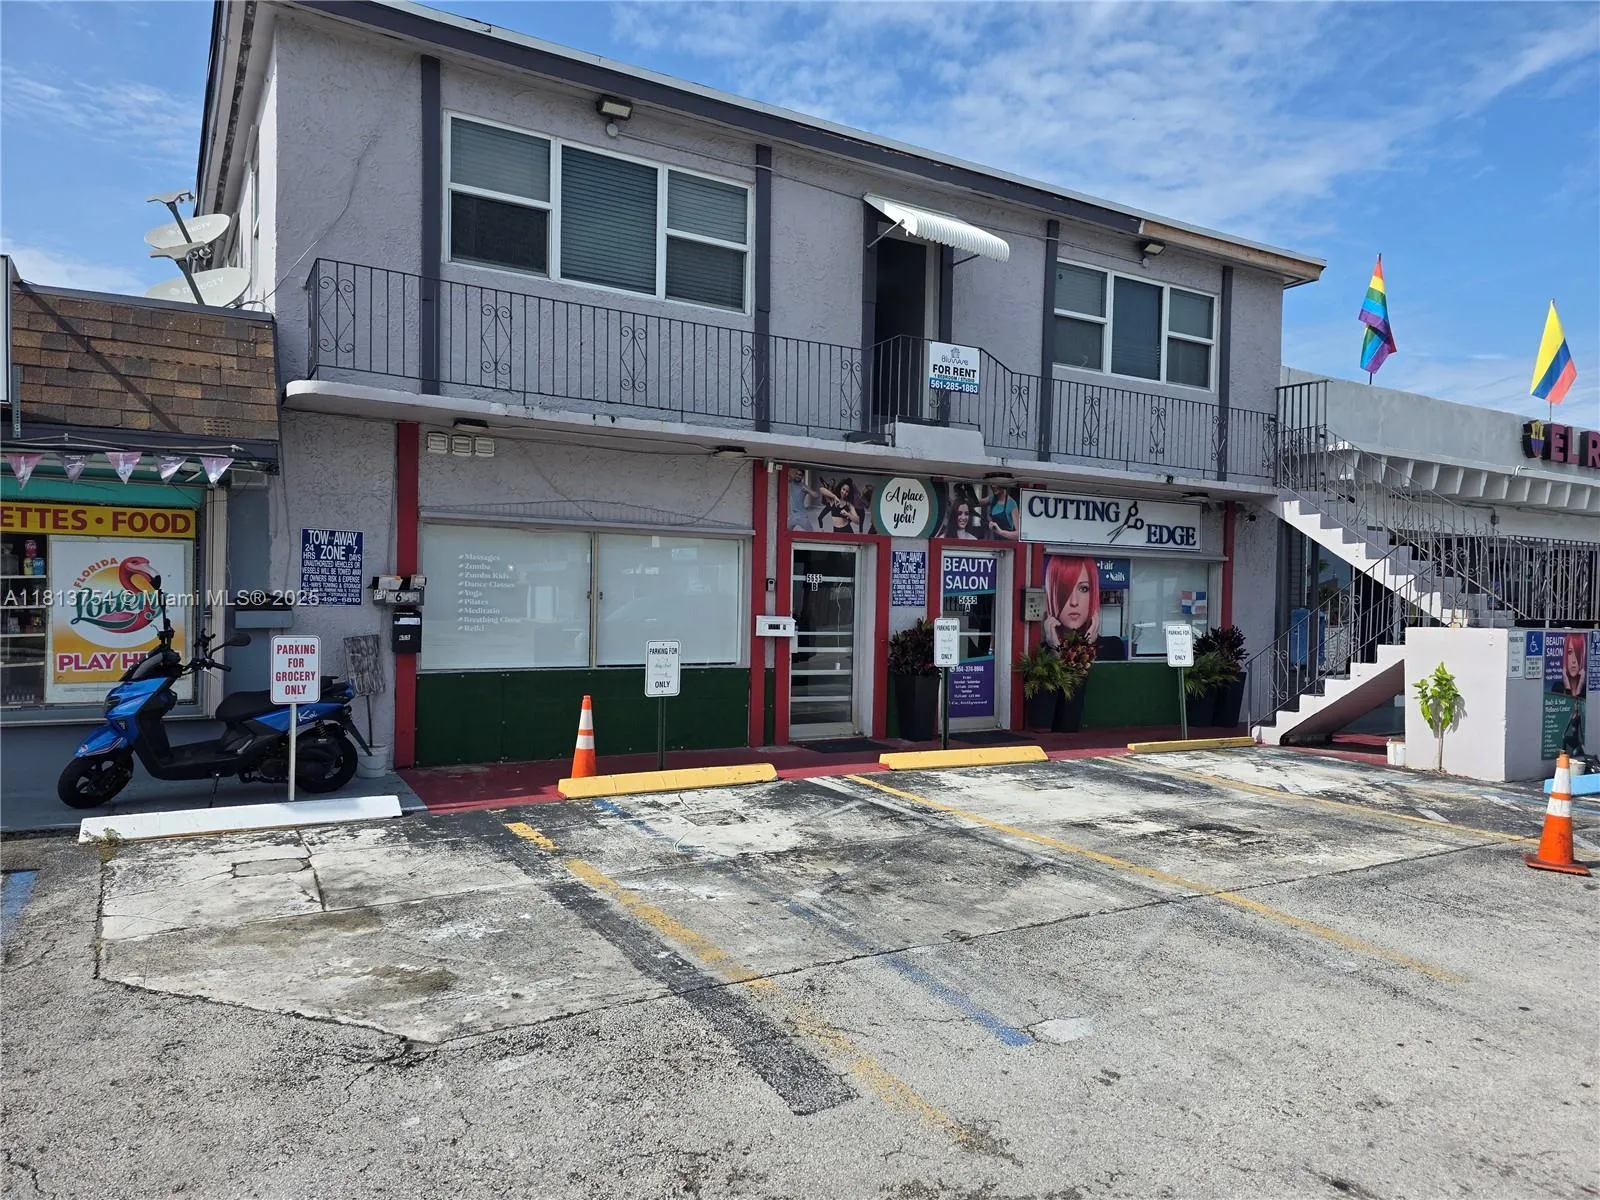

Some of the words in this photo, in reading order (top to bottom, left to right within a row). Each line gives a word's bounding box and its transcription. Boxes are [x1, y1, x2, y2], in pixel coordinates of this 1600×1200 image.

[932, 364, 951, 375] FOR
[953, 367, 977, 378] RENT
[1547, 423, 1579, 464] EL
[886, 486, 901, 503] A
[901, 489, 924, 505] place
[904, 501, 913, 514] for
[1028, 495, 1121, 523] CUTTING
[0, 507, 87, 531] ETTES
[112, 511, 191, 533] FOOD
[894, 509, 916, 529] you!
[1145, 524, 1197, 546] EDGE
[305, 544, 315, 552] 24
[320, 545, 346, 560] ZONE
[349, 554, 361, 562] DAYS
[73, 557, 119, 588] FLORIDA
[902, 562, 917, 573] ZONE
[944, 558, 994, 573] BEAUTY
[945, 575, 989, 590] SALON
[396, 593, 402, 602] 6
[959, 596, 977, 604] 5655
[70, 588, 164, 624] Lottery
[1545, 637, 1565, 646] BEAUTY
[277, 644, 316, 655] PARKING
[1546, 648, 1563, 657] SALON
[58, 653, 117, 672] PLAY
[288, 658, 305, 668] FOR
[275, 671, 316, 682] GROCERY
[285, 685, 307, 695] ONLY
